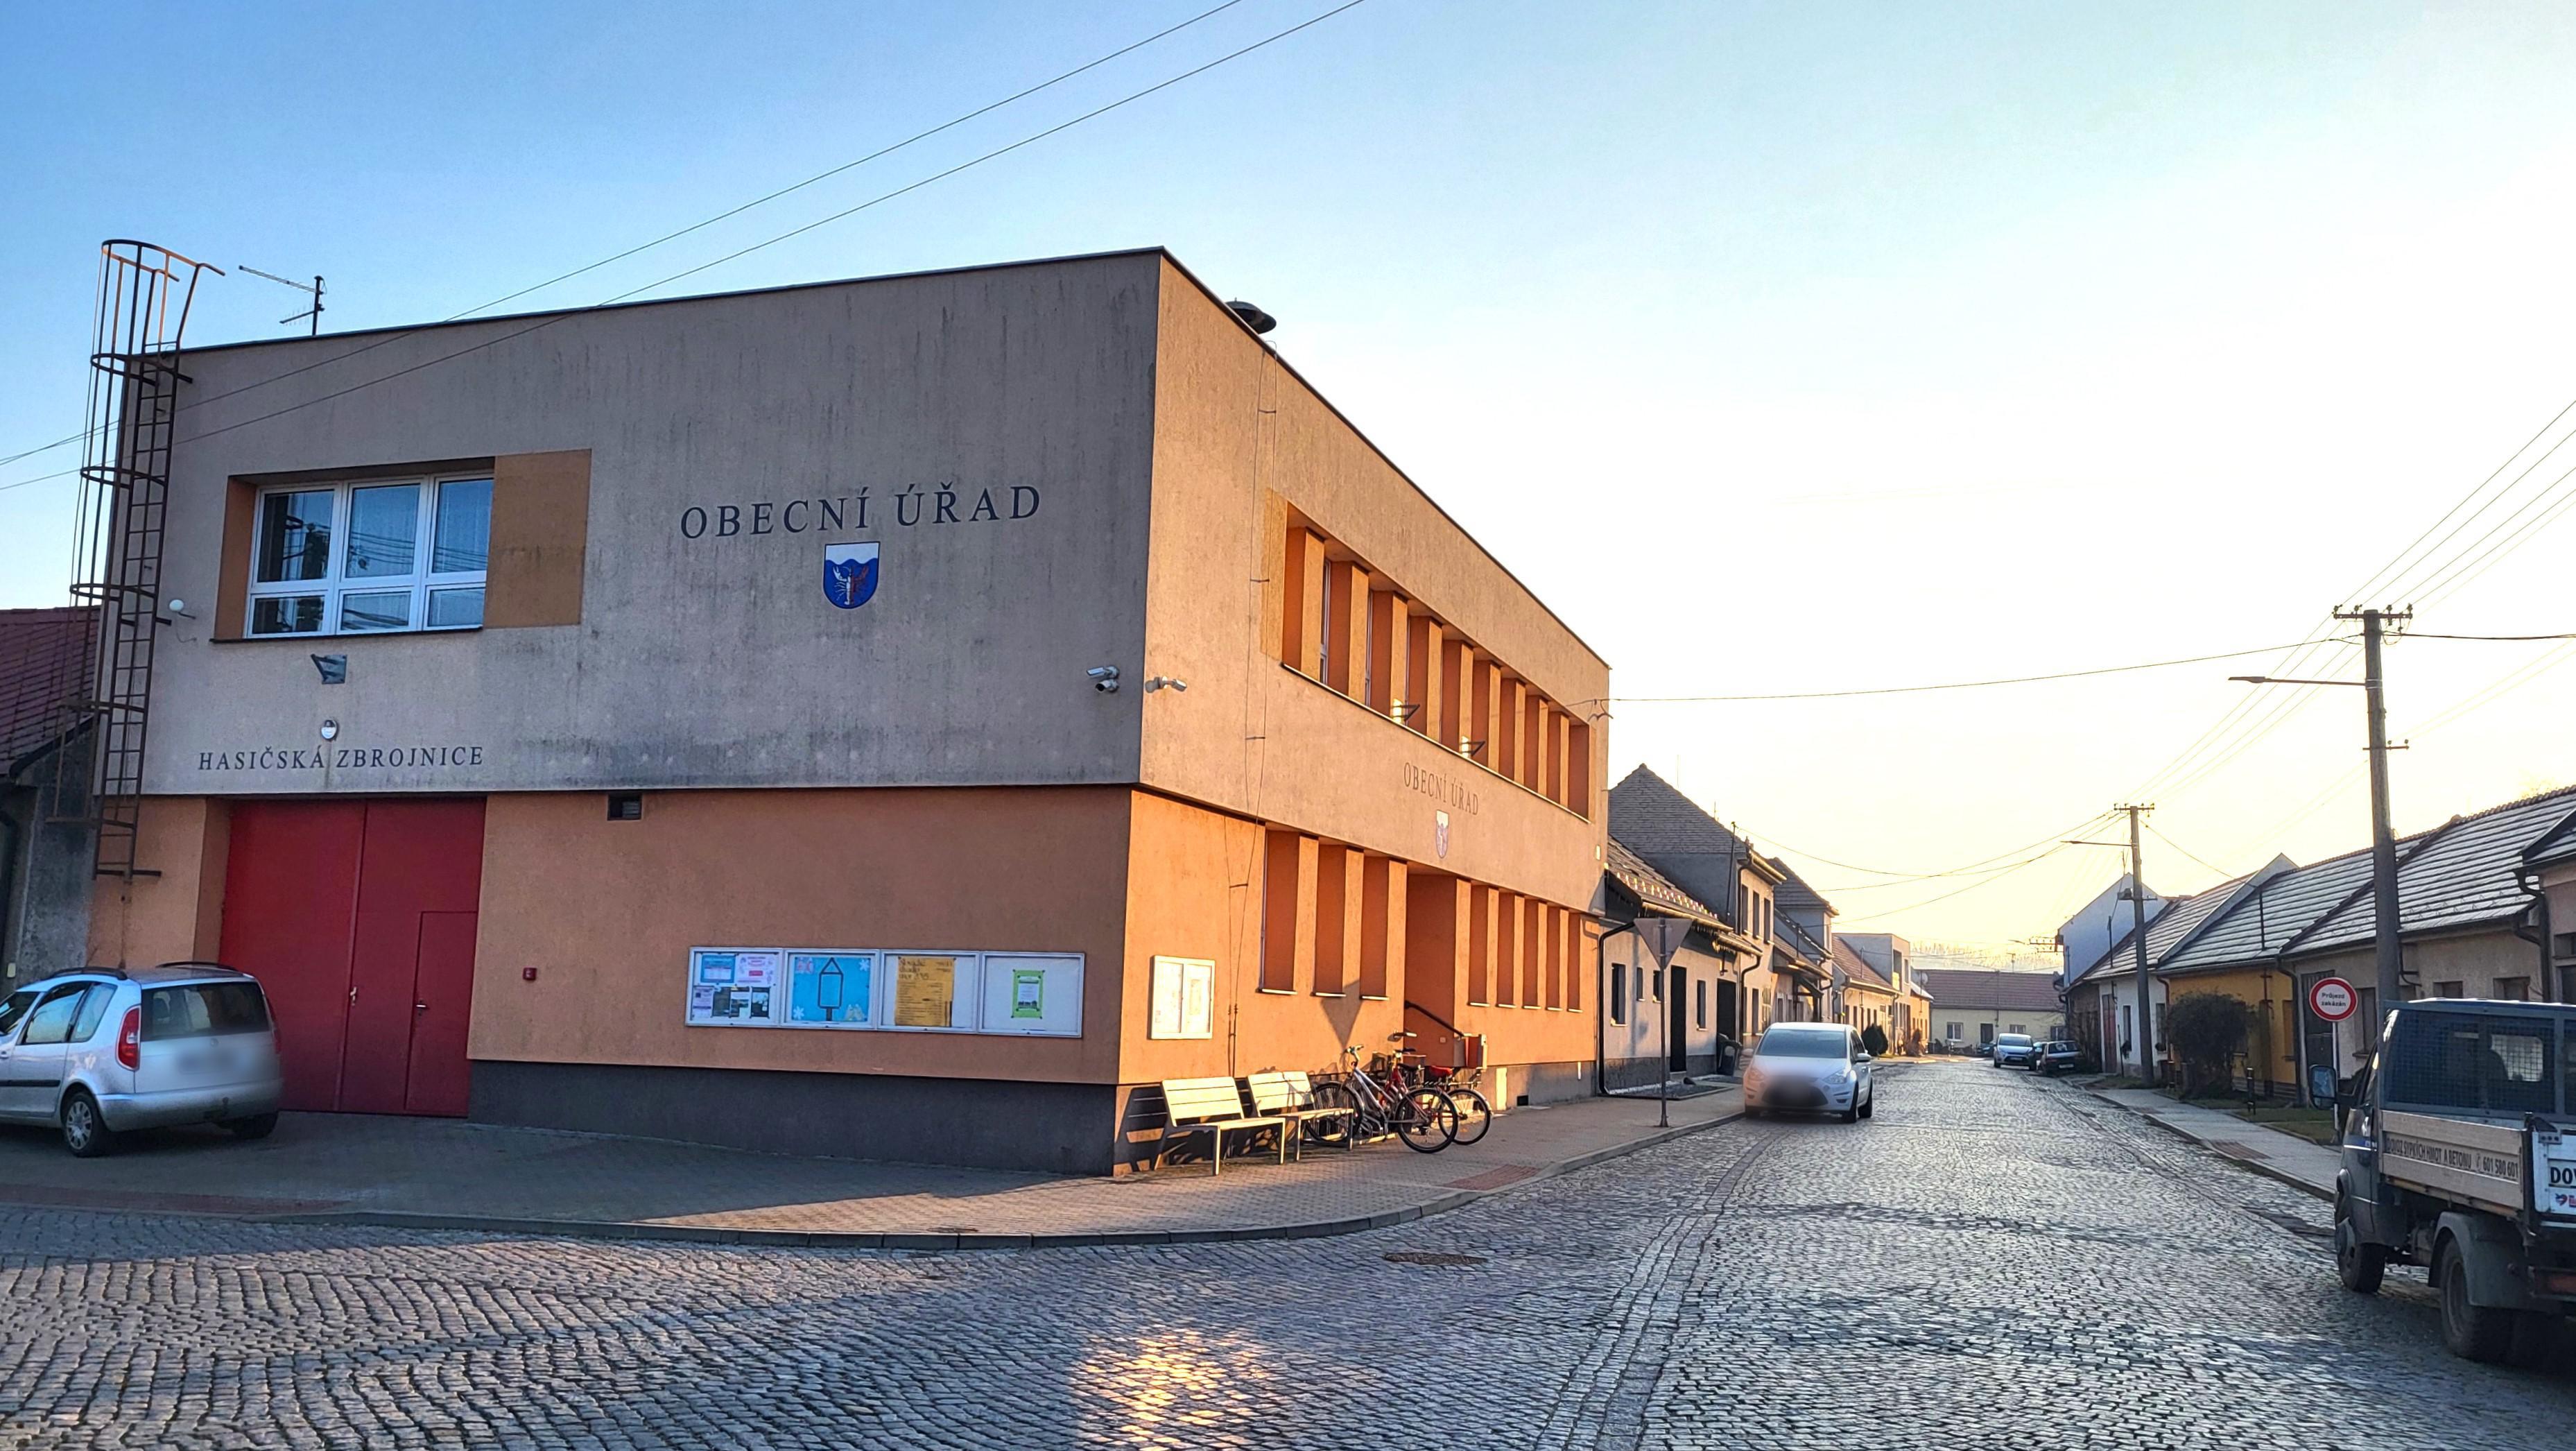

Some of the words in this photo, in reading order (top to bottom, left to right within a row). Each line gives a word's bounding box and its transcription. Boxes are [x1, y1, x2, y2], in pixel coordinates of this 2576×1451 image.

[680, 487, 870, 539] OBECNÍ
[894, 481, 1040, 526] ÚŘAD
[198, 745, 325, 771] HASIČSKÁ
[336, 746, 484, 769] ZBROJNICE
[1403, 762, 1447, 803] OBECNÍ
[1451, 778, 1479, 816] ÚŘAD
[2444, 1149, 2448, 1163] A
[2448, 1149, 2472, 1169] BETONU
[2482, 1156, 2494, 1172] 601
[2495, 1158, 2506, 1176] 580
[2507, 1161, 2518, 1178] 601
[2550, 1167, 2576, 1185] DO
